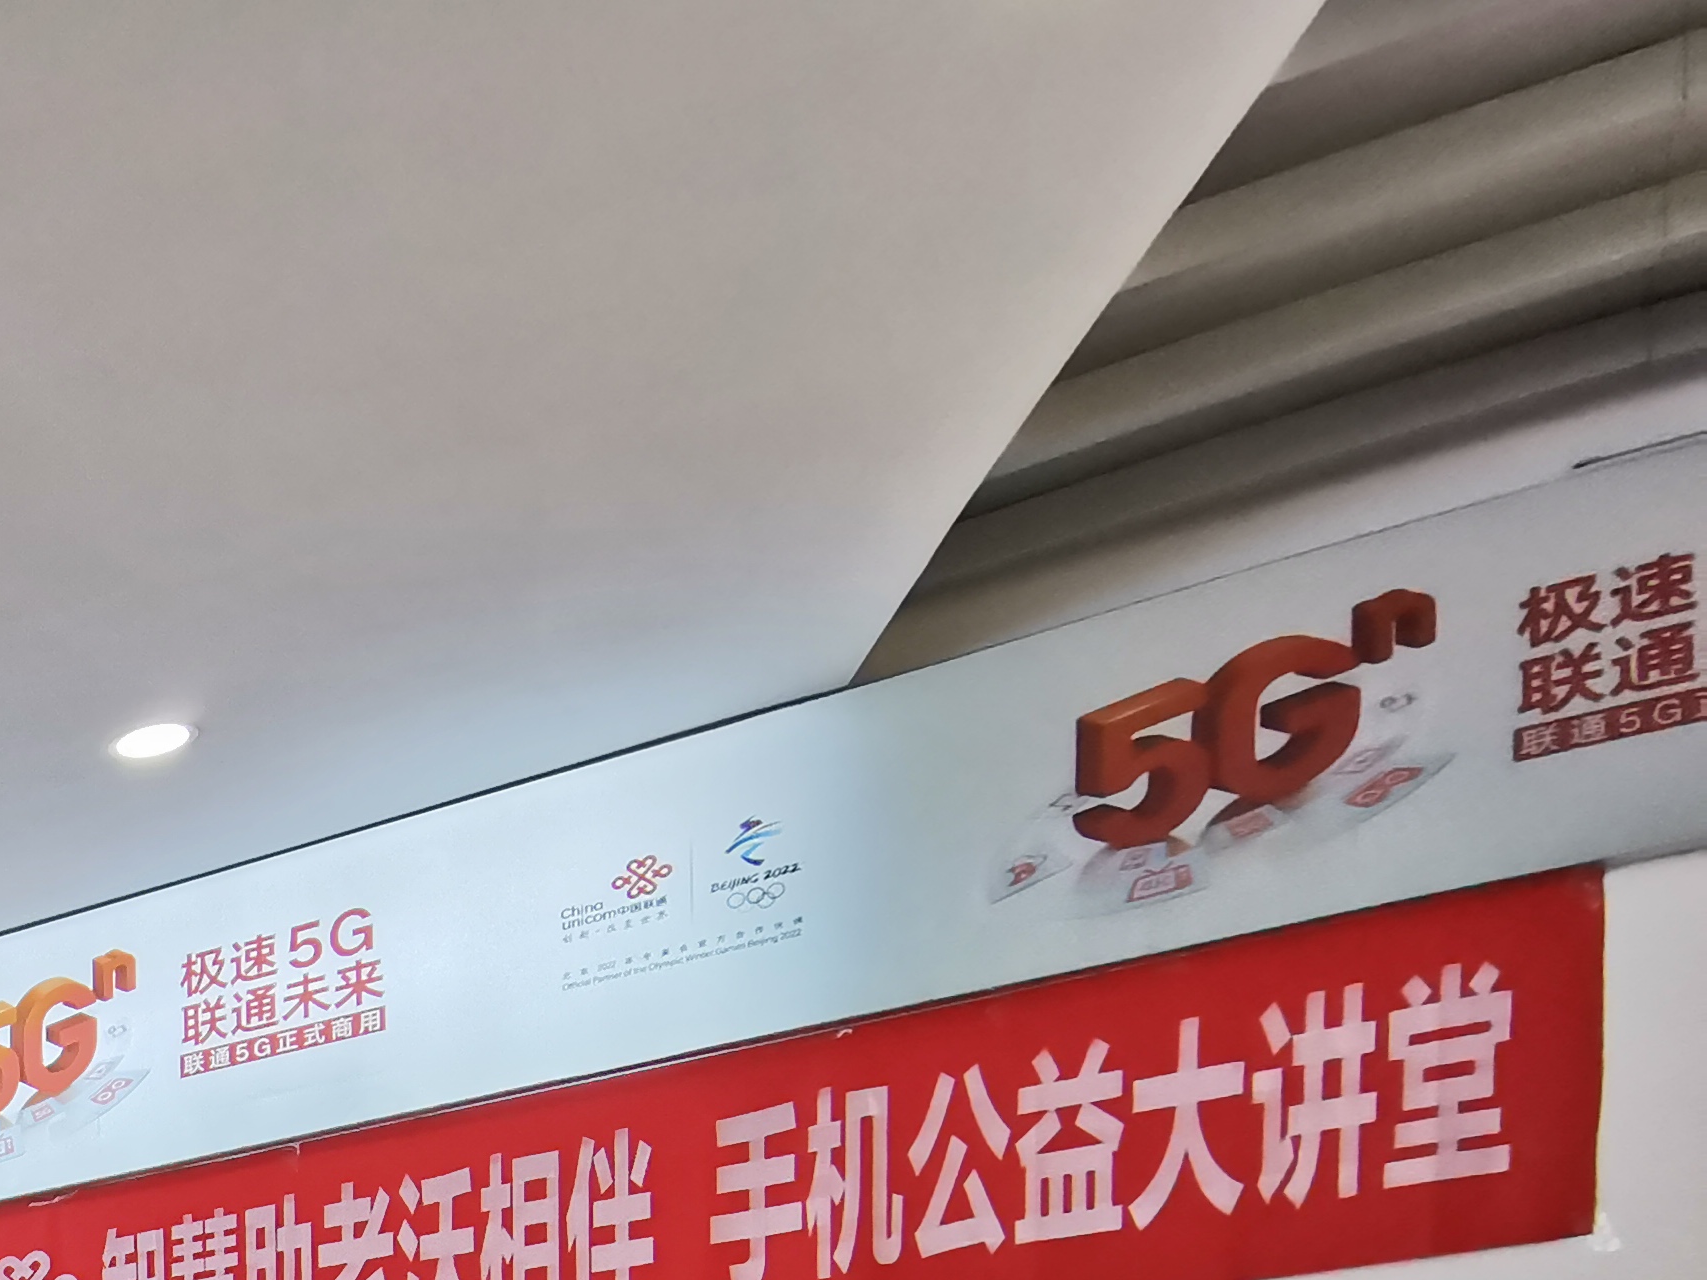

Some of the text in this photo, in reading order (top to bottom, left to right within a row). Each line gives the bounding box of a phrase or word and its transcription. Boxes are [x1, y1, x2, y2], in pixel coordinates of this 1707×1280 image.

[1517, 552, 1698, 648] 极速
[1517, 621, 1701, 715] 联通
[561, 901, 604, 920] China
[710, 862, 802, 894] BEIJING 2022
[180, 907, 374, 998] 极速5G
[181, 958, 386, 1046] 联通未来
[183, 1009, 381, 1075] 联通5G正式商用
